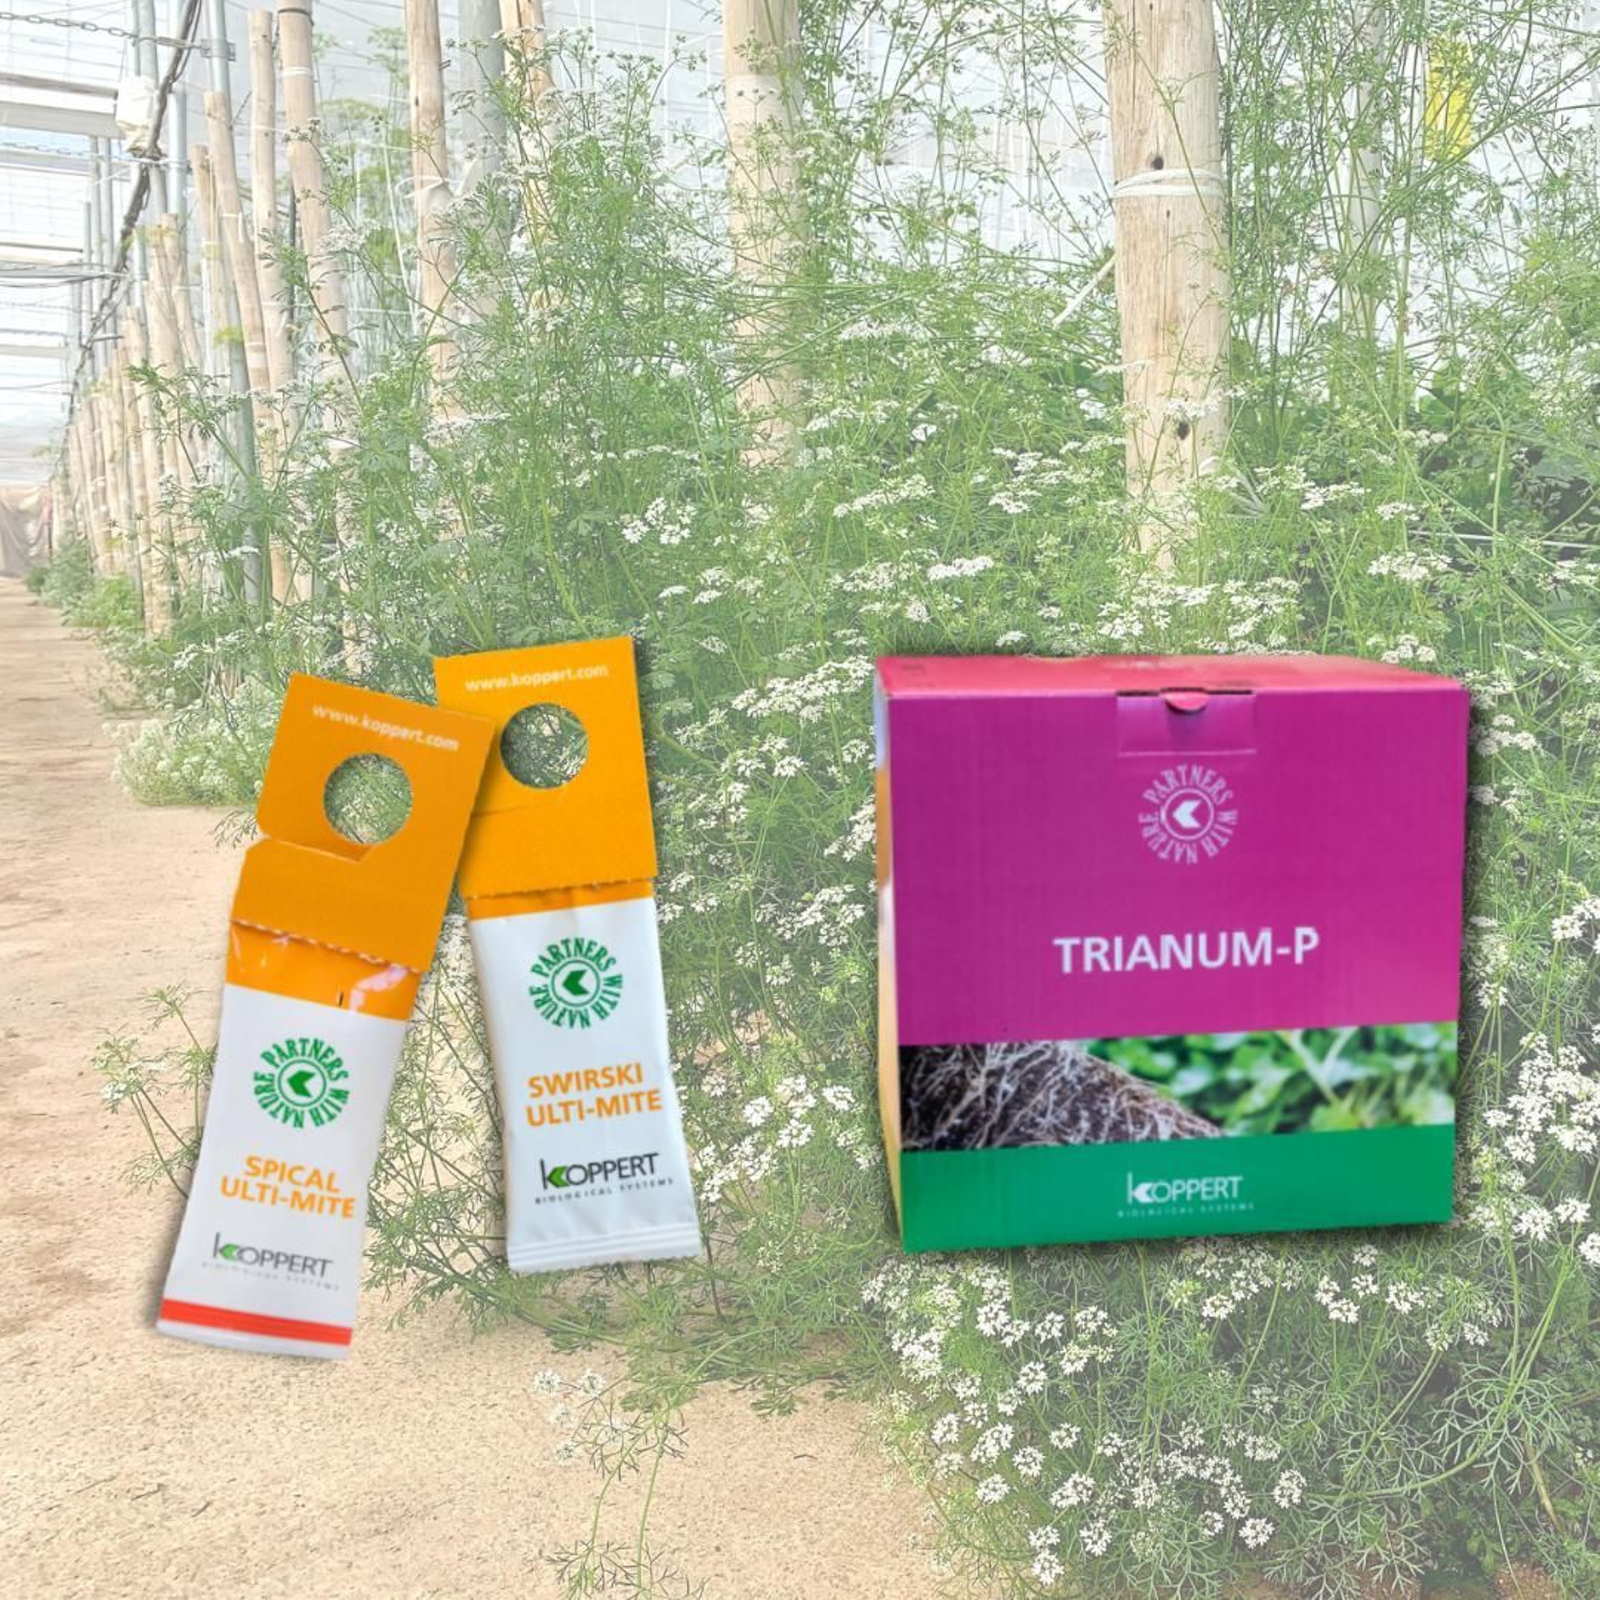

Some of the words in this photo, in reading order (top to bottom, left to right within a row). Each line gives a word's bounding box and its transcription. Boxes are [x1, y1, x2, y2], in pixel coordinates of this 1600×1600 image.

[465, 664, 609, 692] www.koppert.com
[312, 704, 460, 752] www.koppert.com
[1143, 764, 1233, 806] PARTNERS
[1137, 811, 1198, 865] NATURE
[1200, 809, 1239, 858] WITH
[531, 937, 617, 978] PARTNERS
[1053, 926, 1320, 973] TRIANUM-P
[529, 984, 591, 1030] NATURE
[591, 972, 623, 1021] WITH
[260, 1037, 349, 1082] PARTNERS
[527, 1062, 643, 1099] SWIRSKI
[253, 1071, 304, 1129] NATURE
[309, 1088, 350, 1127] WITH
[526, 1089, 663, 1126] ULTI-MITE
[244, 1155, 340, 1194] SPICAL
[539, 1152, 660, 1190] KOPPERT
[220, 1175, 356, 1219] ULTI-MITE
[212, 1231, 334, 1278] KOPPERT
